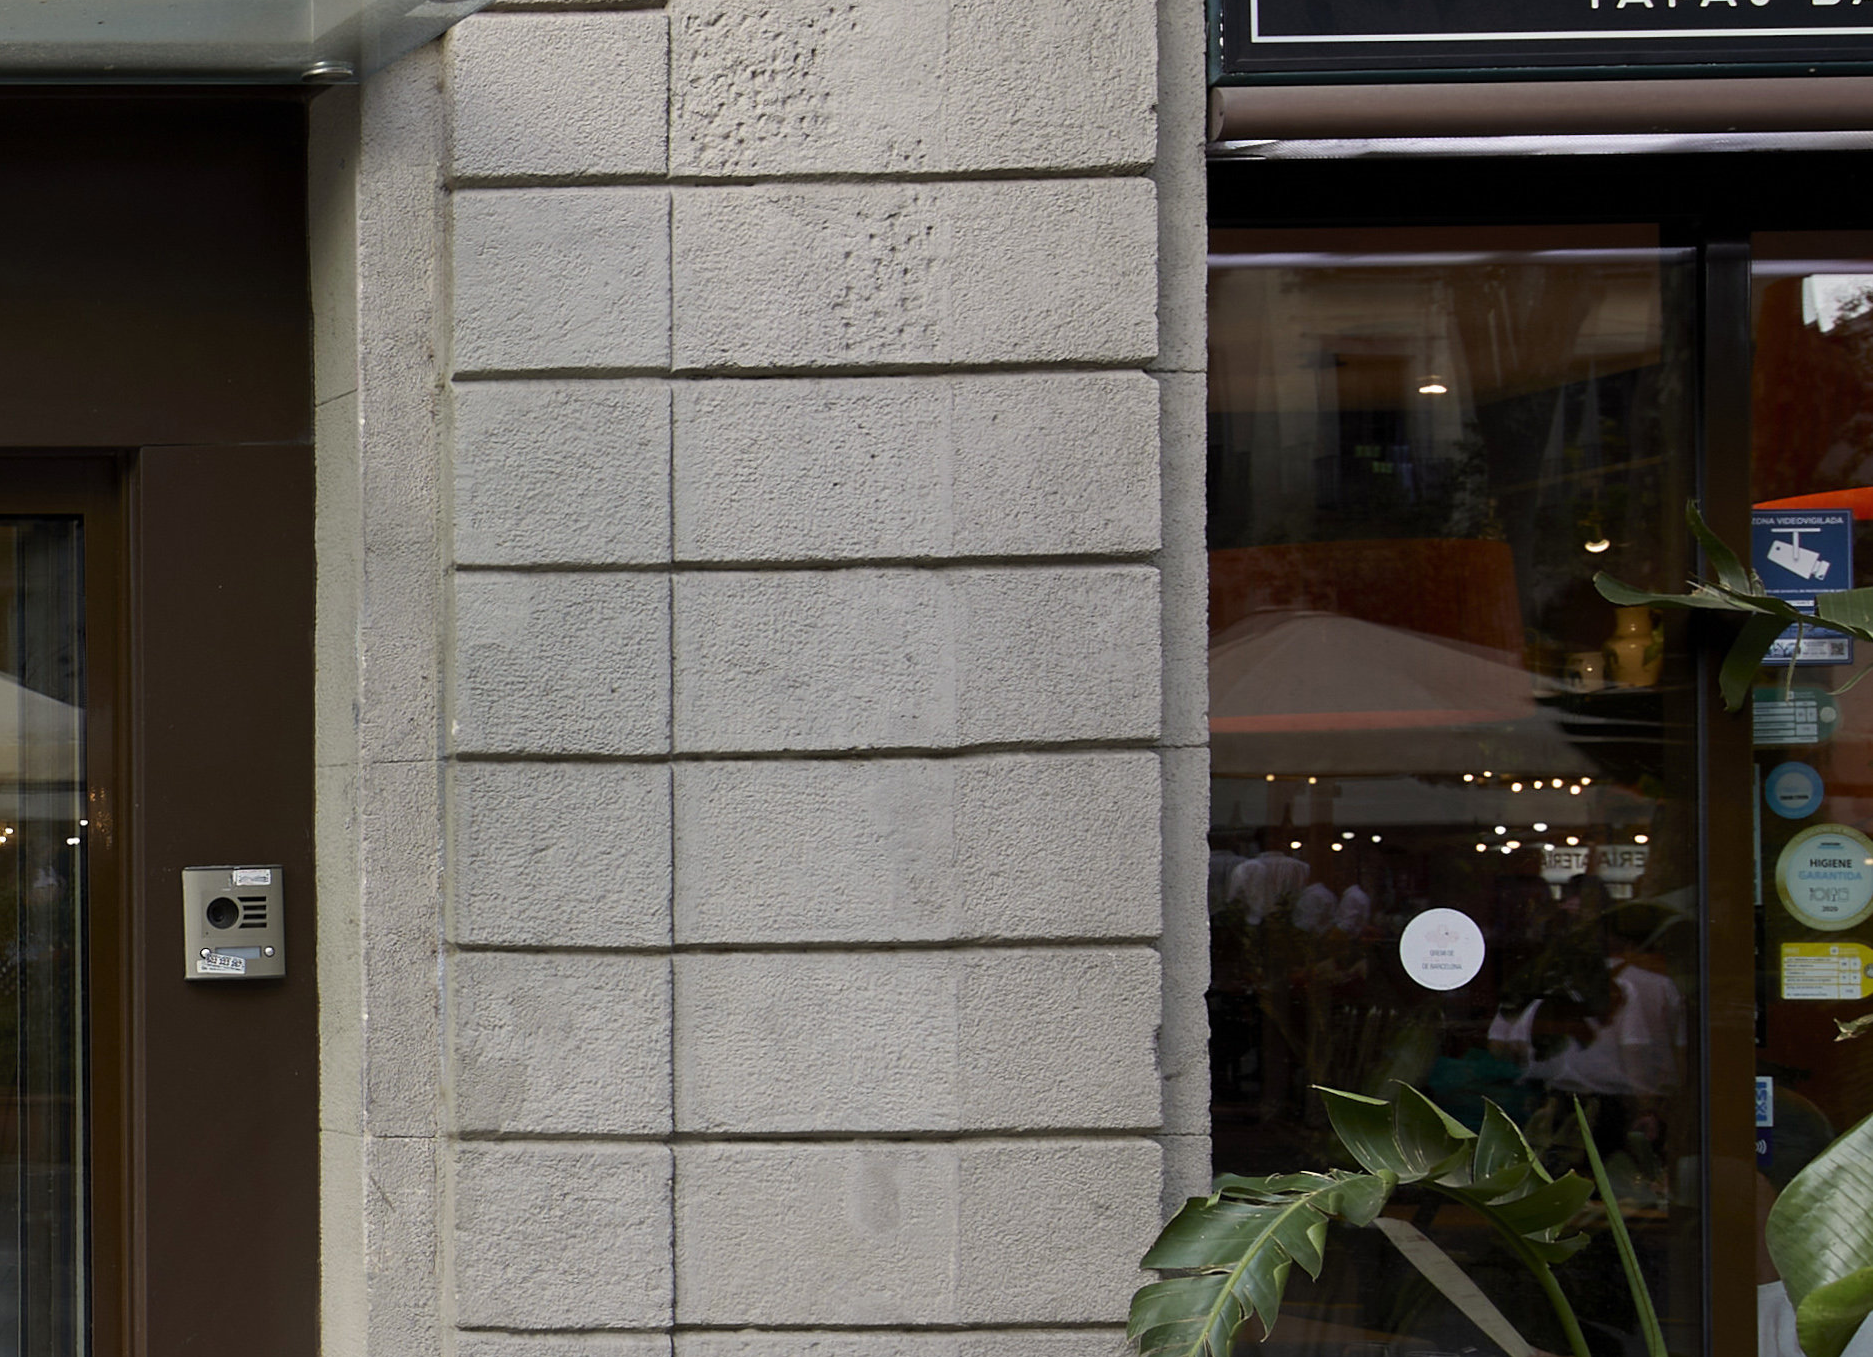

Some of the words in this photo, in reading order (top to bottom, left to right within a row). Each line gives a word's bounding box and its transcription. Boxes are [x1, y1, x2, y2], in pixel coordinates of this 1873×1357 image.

[1776, 515, 1844, 525] VIDEOVIGILADA
[1809, 858, 1853, 869] HIGIENE
[1798, 870, 1863, 881] GARANTIDA
